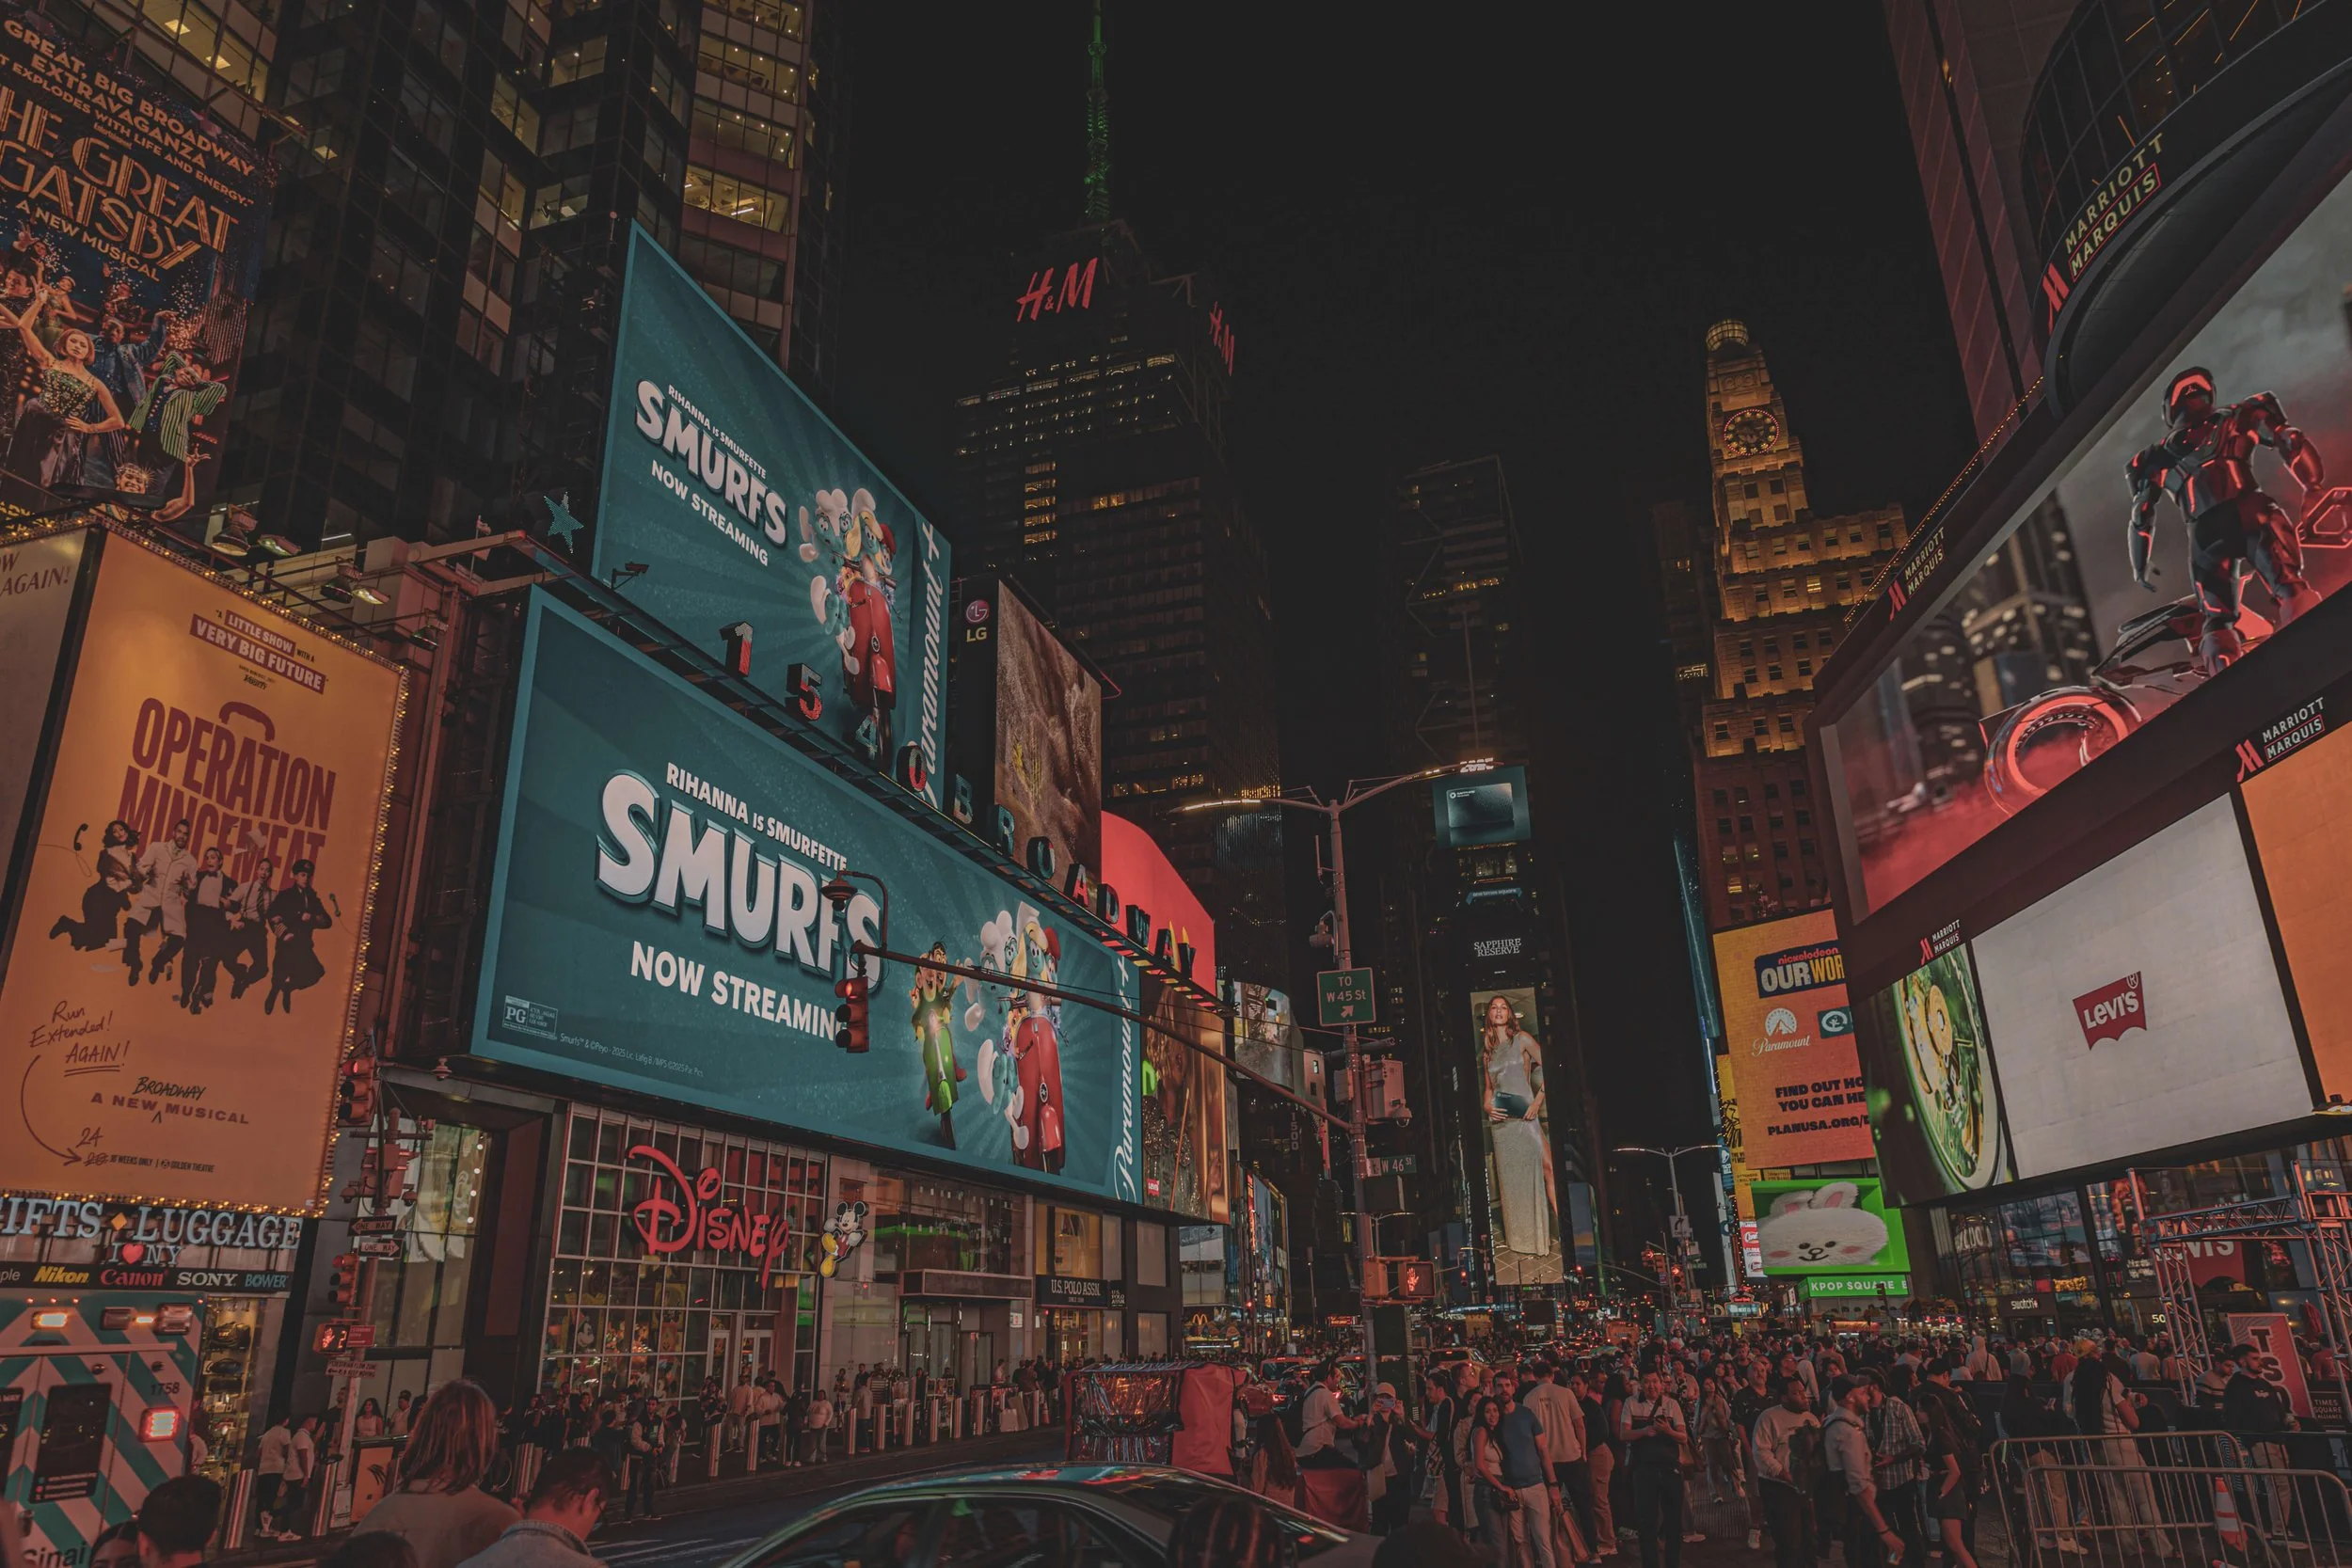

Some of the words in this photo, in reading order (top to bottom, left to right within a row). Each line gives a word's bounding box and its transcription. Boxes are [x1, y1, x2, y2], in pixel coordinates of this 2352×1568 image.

[4, 20, 87, 80] GREAT,
[94, 71, 134, 105] BIG
[139, 98, 255, 177] BROADWAY
[31, 53, 207, 169] EXTRAVAGANZA
[12, 62, 91, 114] EXPLODES
[94, 108, 131, 138] WITH
[134, 133, 163, 157] LIFE
[165, 152, 193, 175] AND
[0, 138, 201, 271] GATSBY
[72, 136, 239, 254] GREAT
[2063, 132, 2164, 254] MARRIOTT
[2071, 171, 2156, 277] MARQUIS
[15, 198, 31, 214] A
[35, 203, 82, 238] NEW
[82, 235, 161, 282] MUSICAL
[1016, 256, 1098, 323] H&M
[668, 384, 711, 430] RIHANNA
[720, 431, 767, 480] SMURFETTE
[635, 378, 787, 548] SMURFS
[651, 459, 689, 501] NOW
[691, 492, 770, 567] STREAMING
[1904, 527, 1945, 579] MARRIOTT
[1906, 548, 1944, 595] MARQUIS
[197, 618, 238, 650] VERY
[238, 639, 266, 665] BIG
[228, 613, 262, 640] LITTLE
[262, 630, 294, 654] SHOW
[965, 626, 988, 642] LG
[2262, 697, 2325, 743] MARRIOTT
[2266, 718, 2323, 759] MARQUIS
[132, 697, 337, 832] OPERATION
[666, 761, 749, 824] RIHANNA
[767, 816, 847, 872] SMURFETTE
[595, 768, 884, 995] SMURFS
[954, 773, 1198, 978] BROADWAY
[1473, 937, 1522, 951] SAPPHIRE
[1931, 919, 1961, 942] MARRIOTT
[1934, 933, 1960, 954] MARQUIS
[1477, 945, 1520, 958] RESERVE
[1778, 946, 1839, 966] nickelodeon
[630, 941, 705, 997] NOW
[1337, 975, 1352, 988] TO
[1760, 960, 1812, 992] OUR
[1326, 990, 1335, 1003] W
[1336, 990, 1353, 1002] 45
[1355, 989, 1366, 1001] St
[52, 999, 86, 1023] Run
[504, 1006, 527, 1023] PG
[29, 1010, 113, 1048] Extended!
[64, 1040, 131, 1067] AGAIN!
[1751, 1035, 1811, 1057] Paramount
[132, 1076, 207, 1101] BROADWAY
[1774, 1084, 1809, 1099] FIND
[1811, 1080, 1841, 1094] OUT
[90, 1092, 103, 1104] A
[112, 1094, 159, 1112] NEW
[165, 1102, 249, 1125] MUSICAL
[1778, 1100, 1810, 1113] YOU
[1812, 1096, 1842, 1109] CAN
[75, 1127, 104, 1148] 24
[1381, 1159, 1389, 1174] W
[1392, 1159, 1405, 1172] 46
[0, 1196, 103, 1239] IFTS
[133, 1205, 304, 1250] LUGGAGE
[357, 1222, 370, 1231] ONE
[375, 1222, 390, 1230] WAY
[109, 1243, 119, 1263] I
[146, 1243, 183, 1265] NY
[382, 1243, 395, 1252] WAY
[0, 1268, 21, 1284] ple
[33, 1265, 90, 1284] Nikon
[100, 1268, 166, 1287] Canon
[176, 1270, 238, 1288] SONY
[245, 1274, 289, 1289] BOWER
[1051, 1279, 1063, 1294] U.S.
[1063, 1280, 1082, 1295] POLO
[1811, 1281, 1843, 1291] KPOP
[2010, 1297, 2034, 1310] swatch
[338, 1330, 347, 1349] 2
[150, 1382, 181, 1396] 1758
[2313, 1399, 2339, 1407] TIMES
